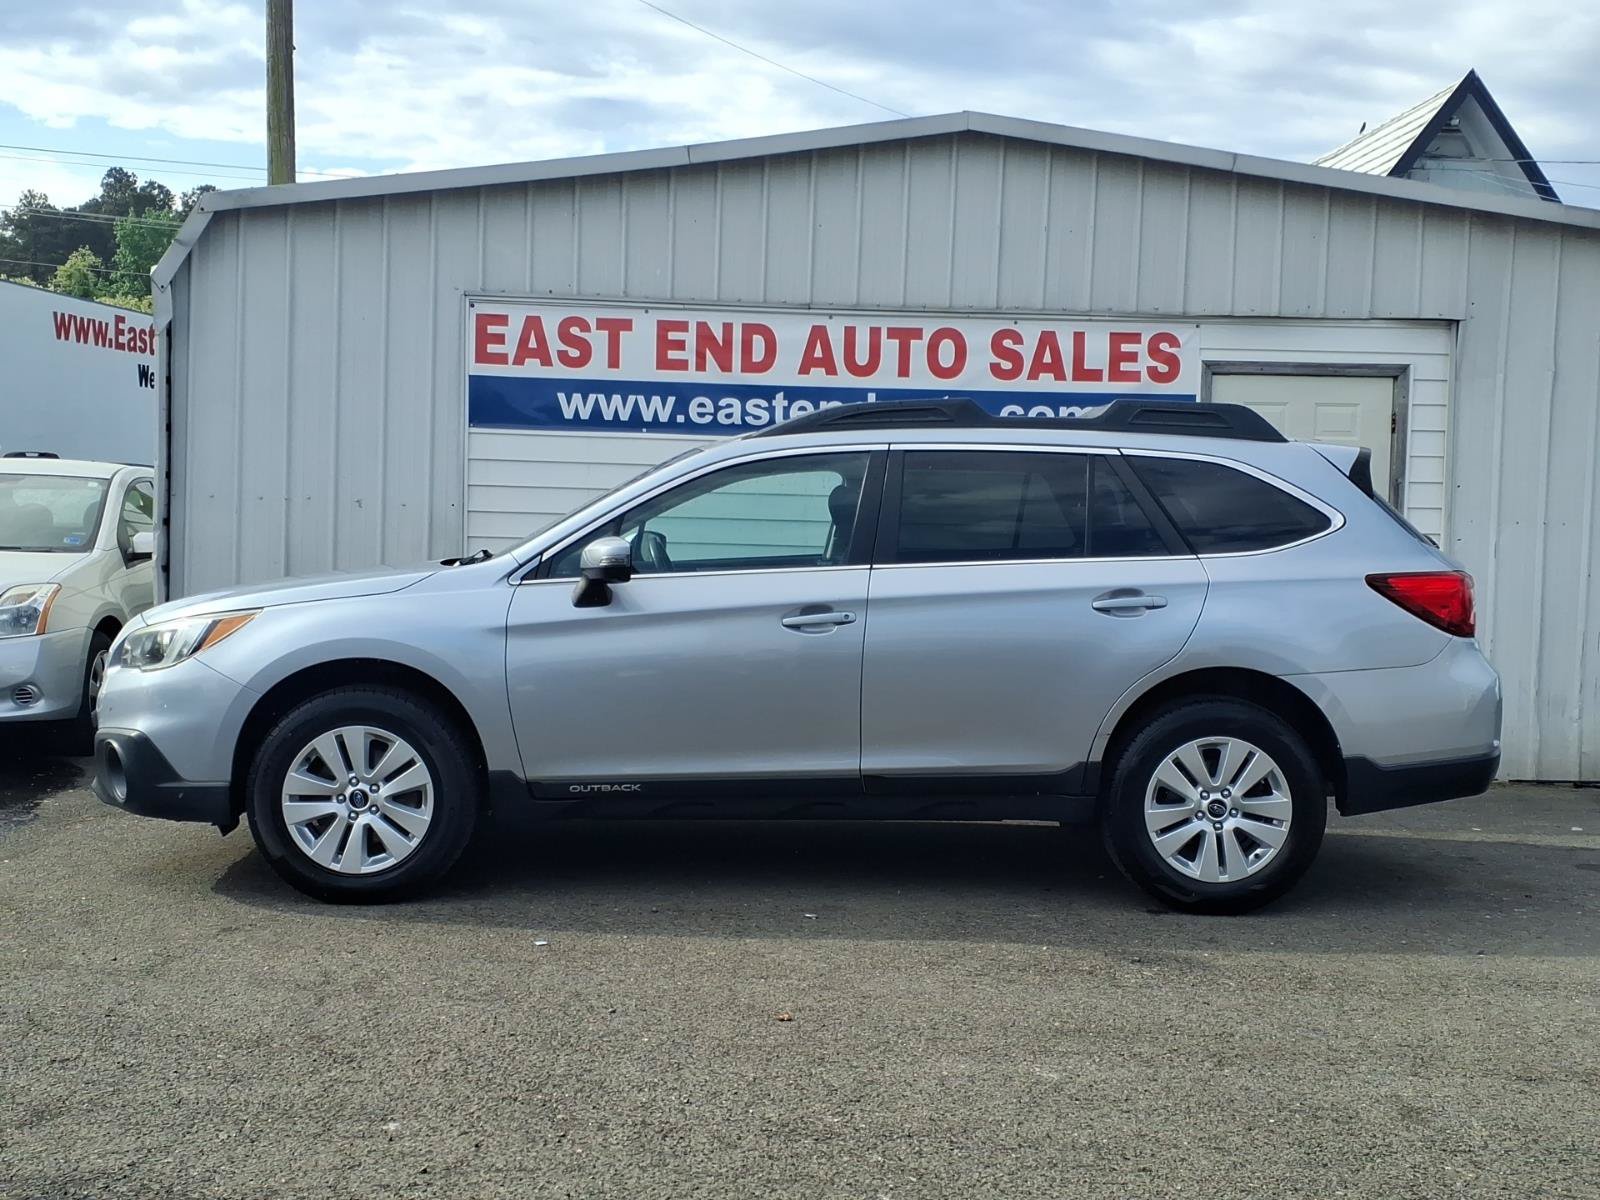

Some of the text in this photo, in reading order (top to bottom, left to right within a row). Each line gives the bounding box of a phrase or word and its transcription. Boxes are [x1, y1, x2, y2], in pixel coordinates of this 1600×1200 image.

[474, 313, 1182, 384] EAST END AUTO SALES
[569, 784, 641, 793] OUTBACK
